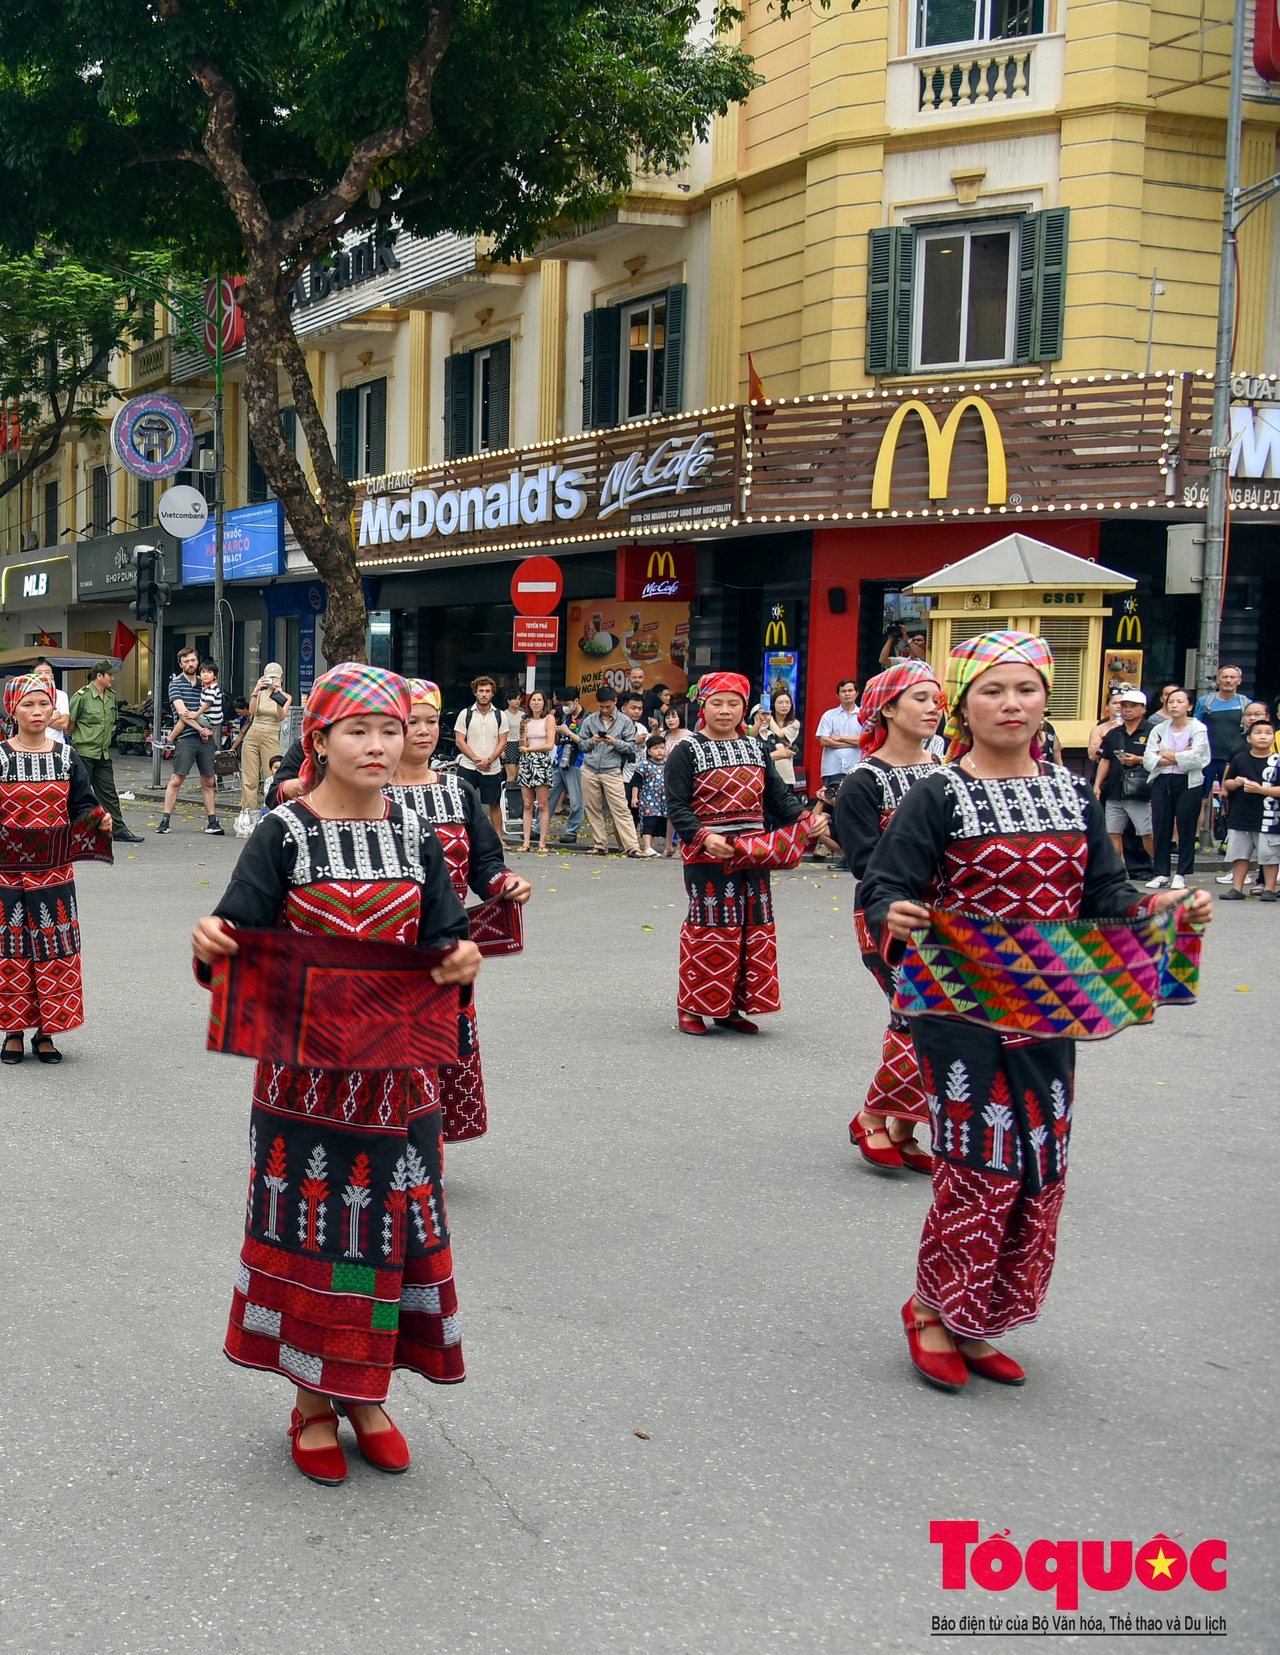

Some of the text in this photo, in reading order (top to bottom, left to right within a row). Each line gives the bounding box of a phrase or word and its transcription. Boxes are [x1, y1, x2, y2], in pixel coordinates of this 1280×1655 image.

[598, 431, 714, 510] McCafé
[1183, 483, 1198, 502] SỐ
[1244, 486, 1261, 503] BÀI
[161, 511, 206, 519] Vietcombank
[358, 466, 588, 546] McDonald's
[23, 573, 47, 597] MLB
[1042, 592, 1085, 604] CSGT
